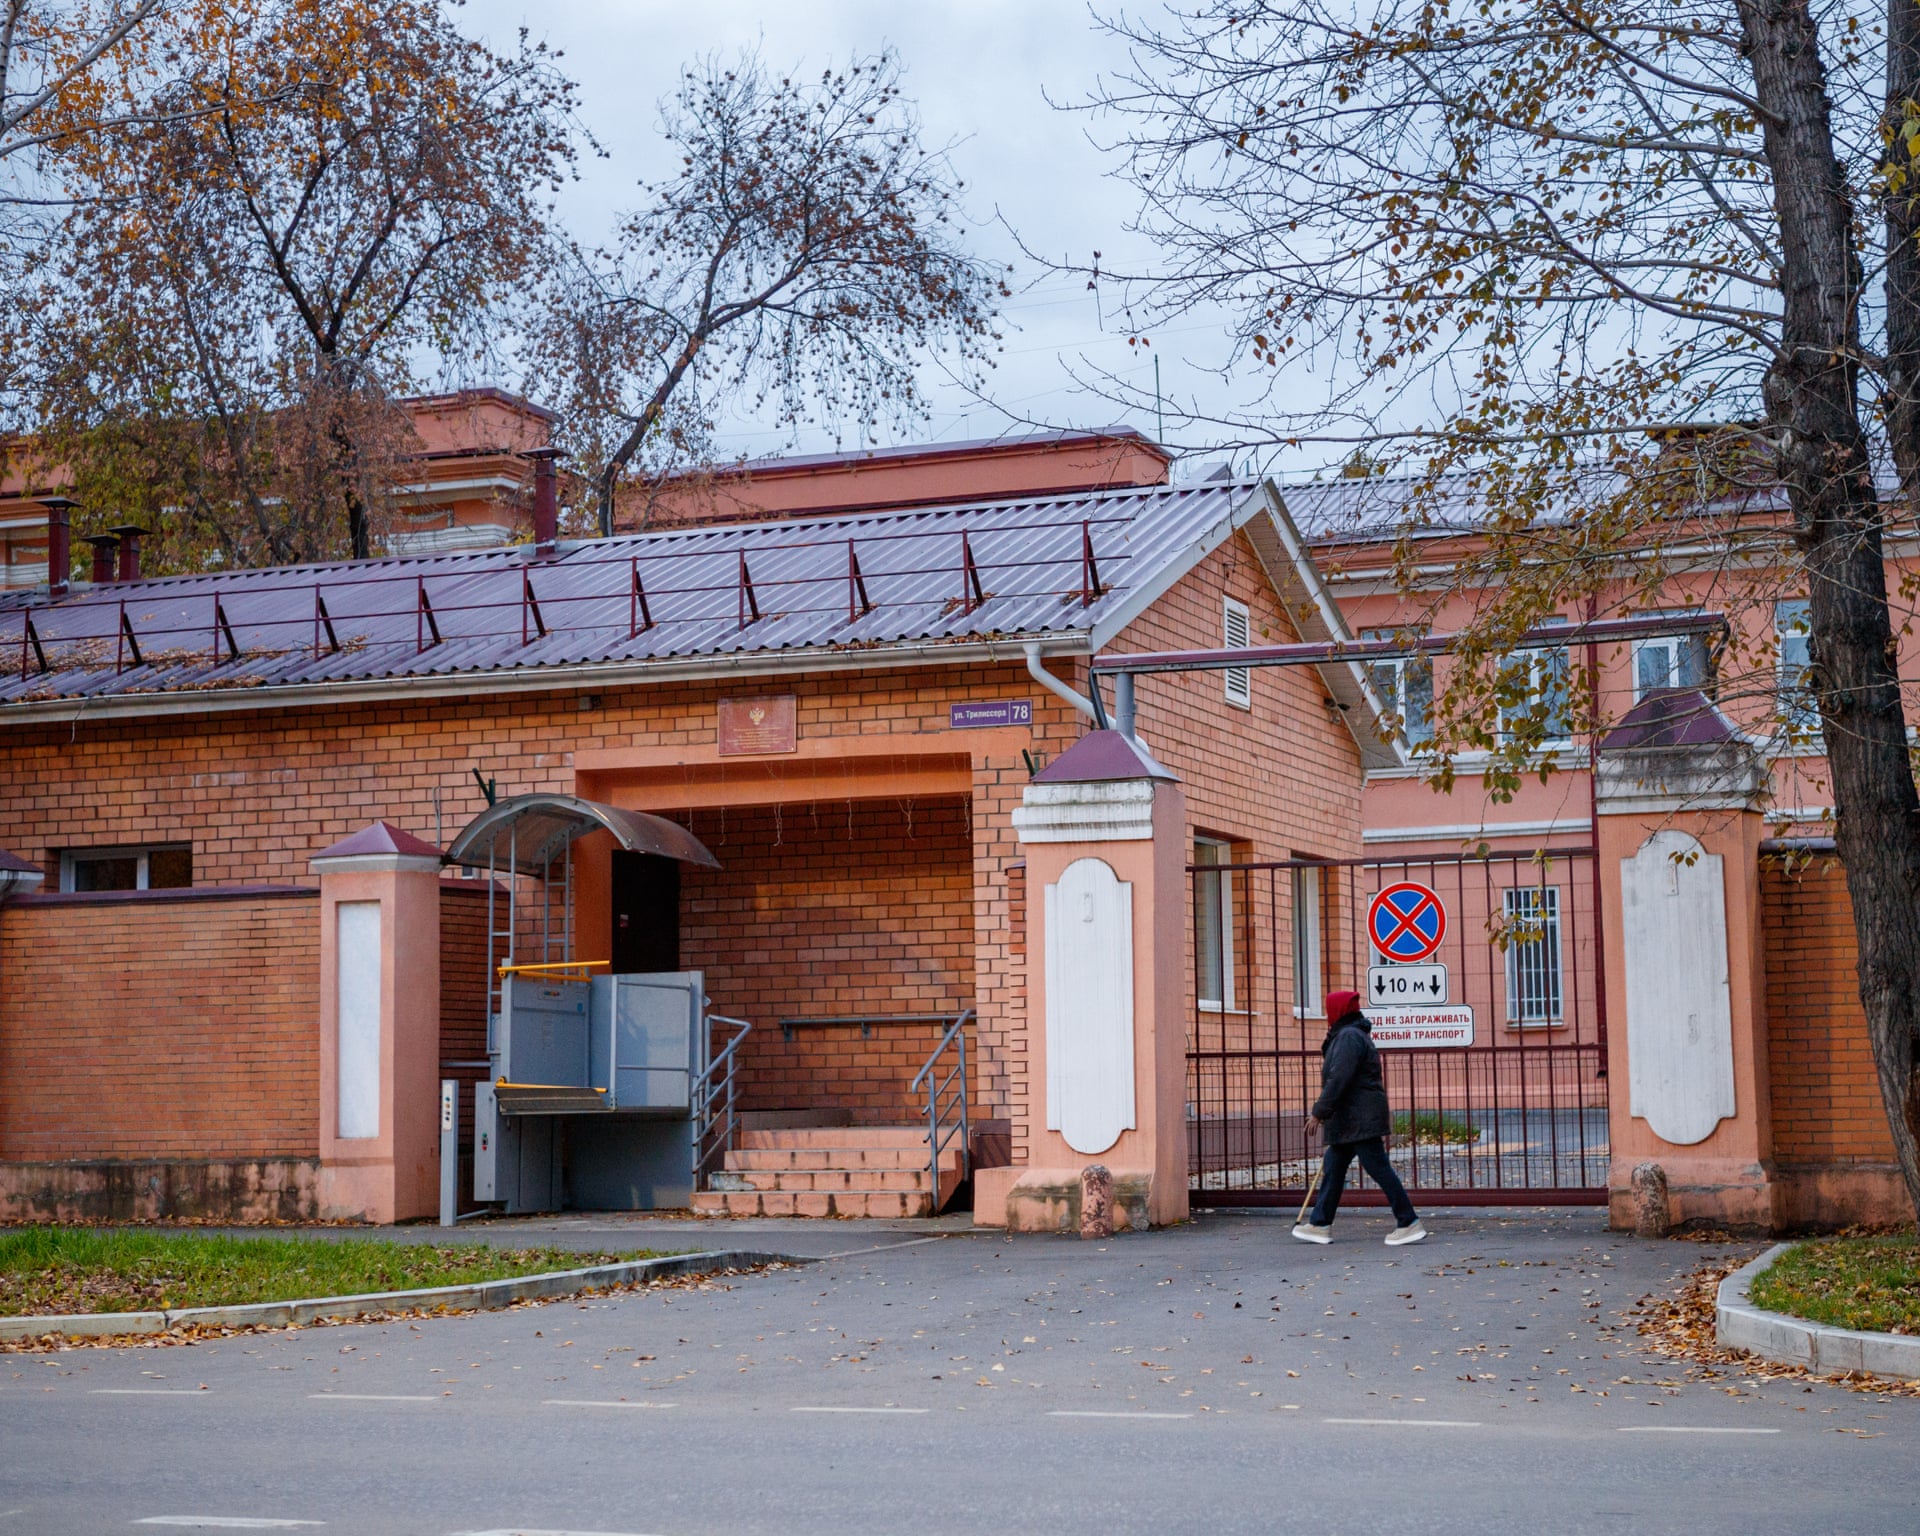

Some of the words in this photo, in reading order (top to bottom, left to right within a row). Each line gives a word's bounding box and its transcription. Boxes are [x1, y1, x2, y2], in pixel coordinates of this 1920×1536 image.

[1012, 705, 1028, 719] 78
[1389, 978, 1406, 992] 10
[1369, 1016, 1383, 1026] ЗД
[1385, 1017, 1396, 1025] НЕ
[1399, 1014, 1469, 1024] ЗАГОРАЖИВАТЬ
[1371, 1030, 1411, 1040] ЖЕБНЫЙ
[1415, 1030, 1464, 1039] ТРАНСПОРТ
